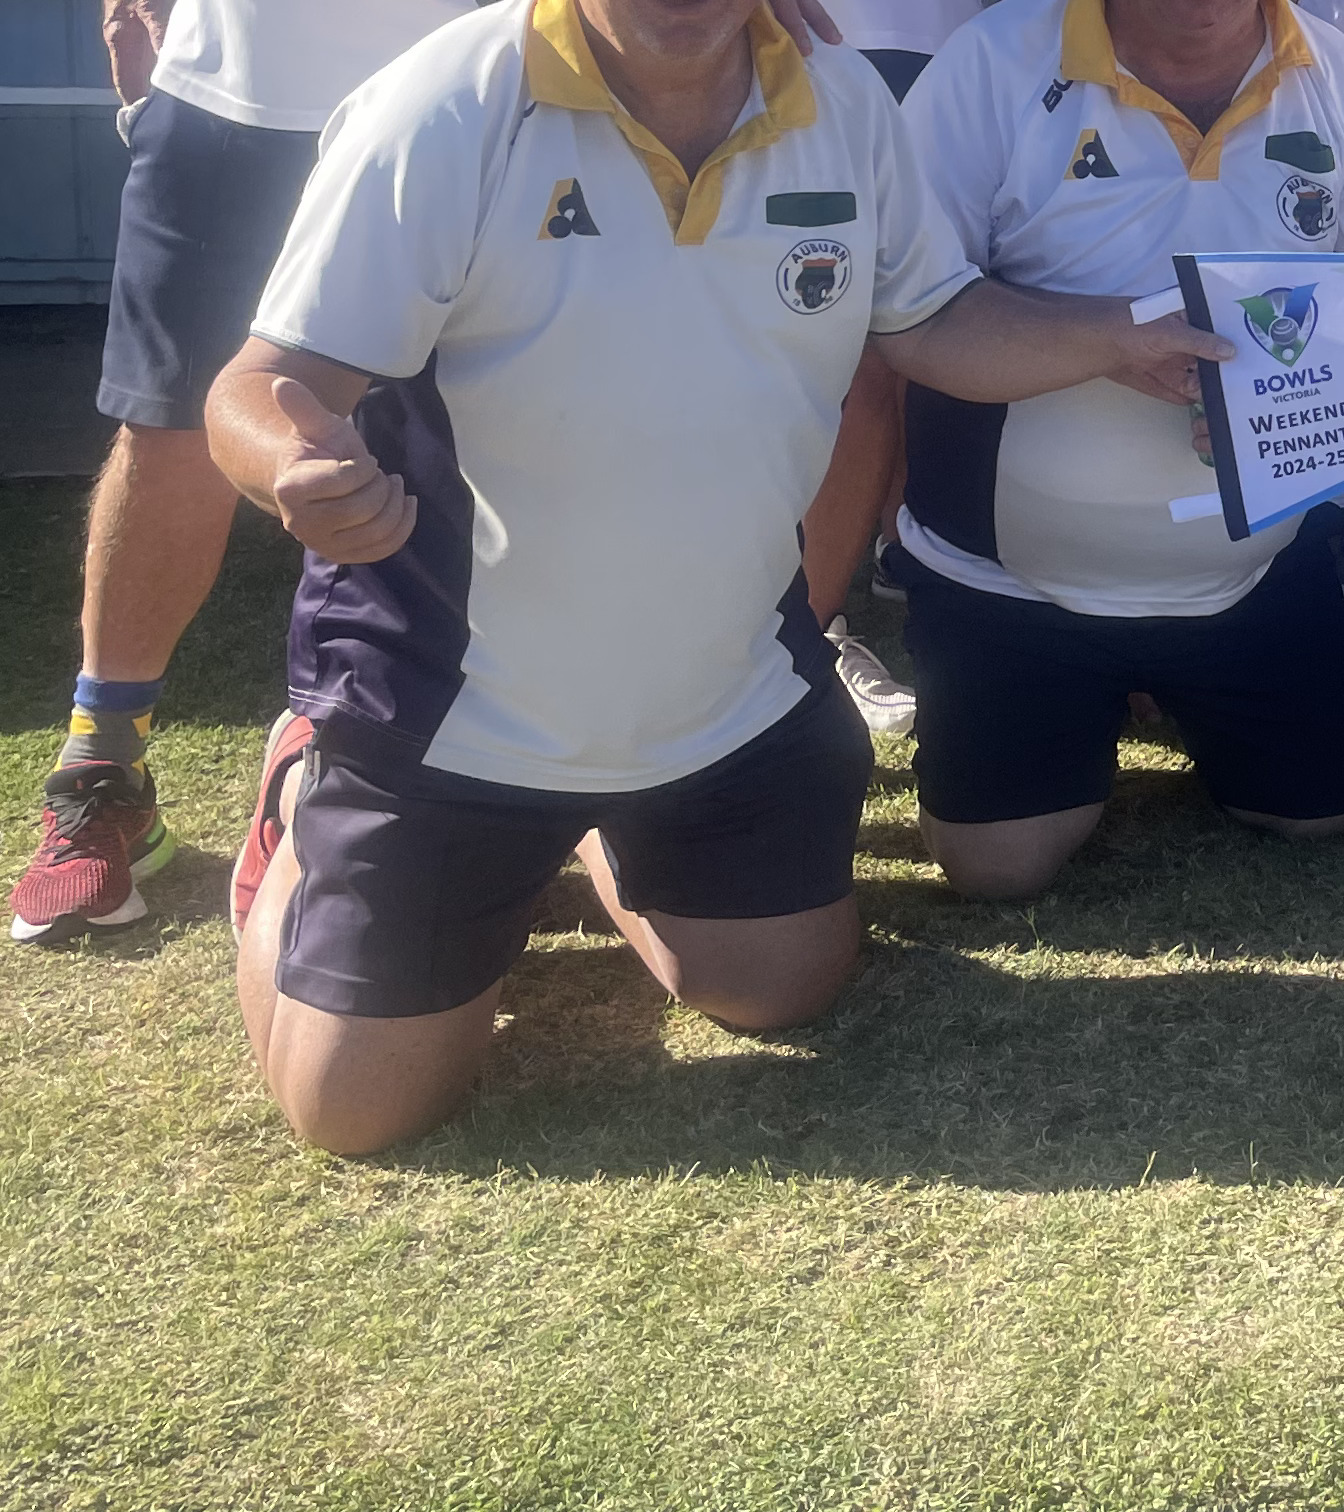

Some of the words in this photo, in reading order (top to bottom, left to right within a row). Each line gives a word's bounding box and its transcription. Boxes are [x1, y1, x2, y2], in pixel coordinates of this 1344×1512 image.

[791, 243, 848, 265] AUBURN
[1253, 364, 1333, 397] BOWLS
[1271, 387, 1322, 404] VICTORIA
